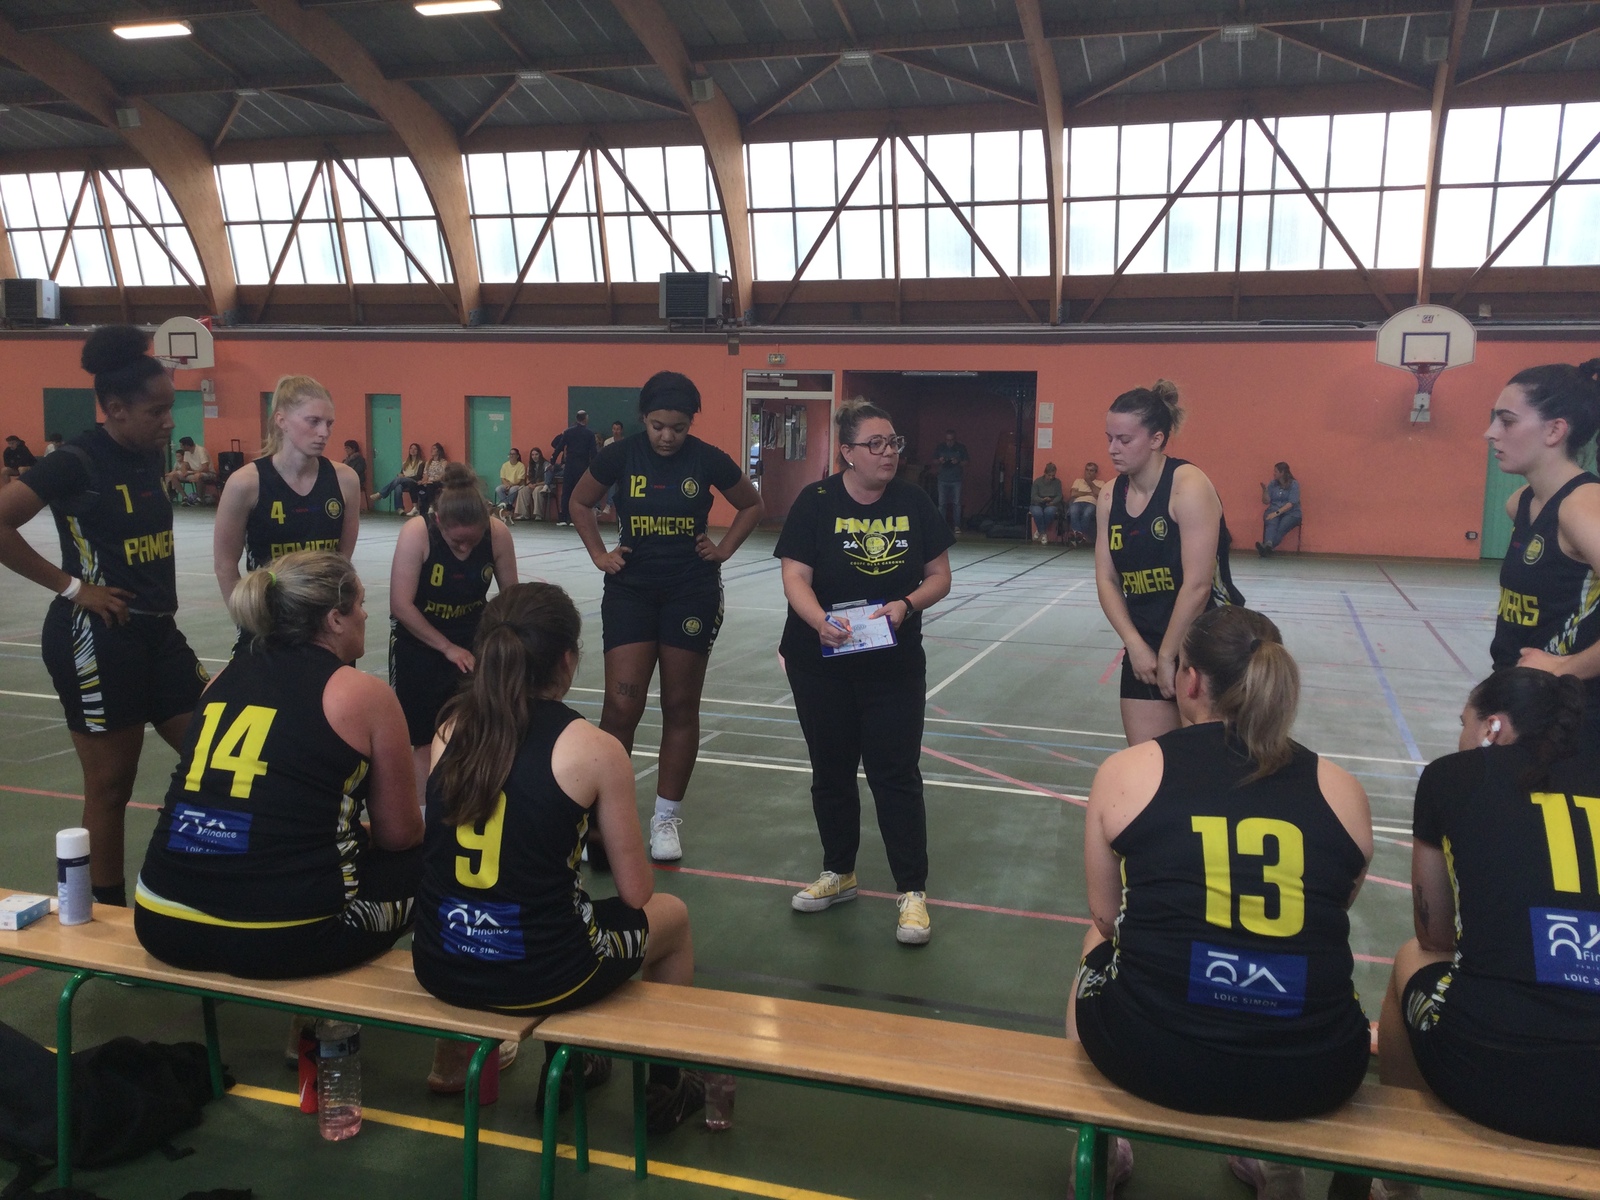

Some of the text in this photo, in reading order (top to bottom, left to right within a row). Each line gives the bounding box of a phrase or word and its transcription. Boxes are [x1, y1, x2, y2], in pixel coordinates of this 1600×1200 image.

[630, 475, 647, 497] 12
[271, 501, 286, 524] 4
[630, 515, 695, 536] PAMIERS
[834, 515, 910, 534] FINALE
[843, 540, 909, 549] 24 25
[430, 563, 444, 587] 8
[184, 701, 278, 799] 14
[202, 828, 237, 839] Finance
[455, 789, 507, 890] 9
[1190, 815, 1305, 937] 13
[1243, 997, 1278, 1008] SIMON
